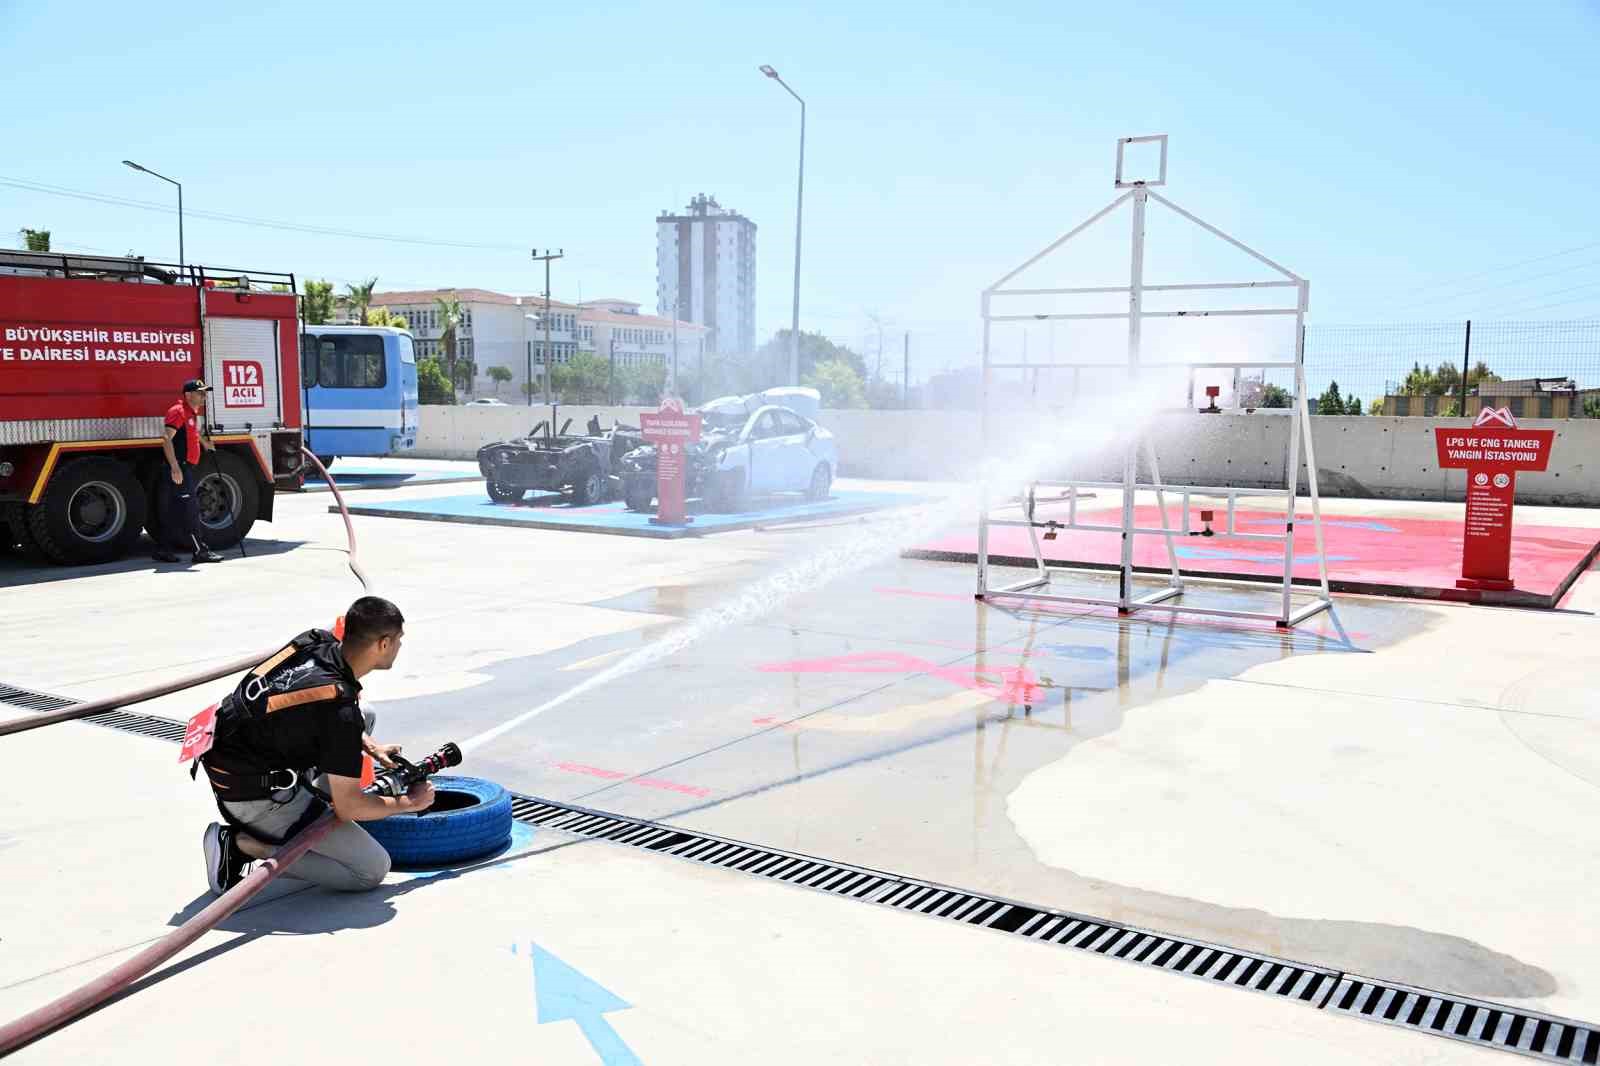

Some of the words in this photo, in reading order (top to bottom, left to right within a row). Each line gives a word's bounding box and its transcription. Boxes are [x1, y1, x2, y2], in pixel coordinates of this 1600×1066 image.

[6, 327, 109, 345] BÜYÜKŞEHİR
[113, 330, 194, 345] BELEDİYESİ
[20, 346, 89, 361] DAİRESİ
[95, 348, 191, 364] BAŞKANLIĞI
[229, 365, 258, 385] 112
[1446, 437, 1465, 447] LPG
[1466, 438, 1479, 448] VE
[1480, 438, 1501, 449] CNG
[1503, 439, 1540, 449] TANKER
[1448, 449, 1482, 460] YANGIN
[1484, 449, 1537, 462] İSTASYONU
